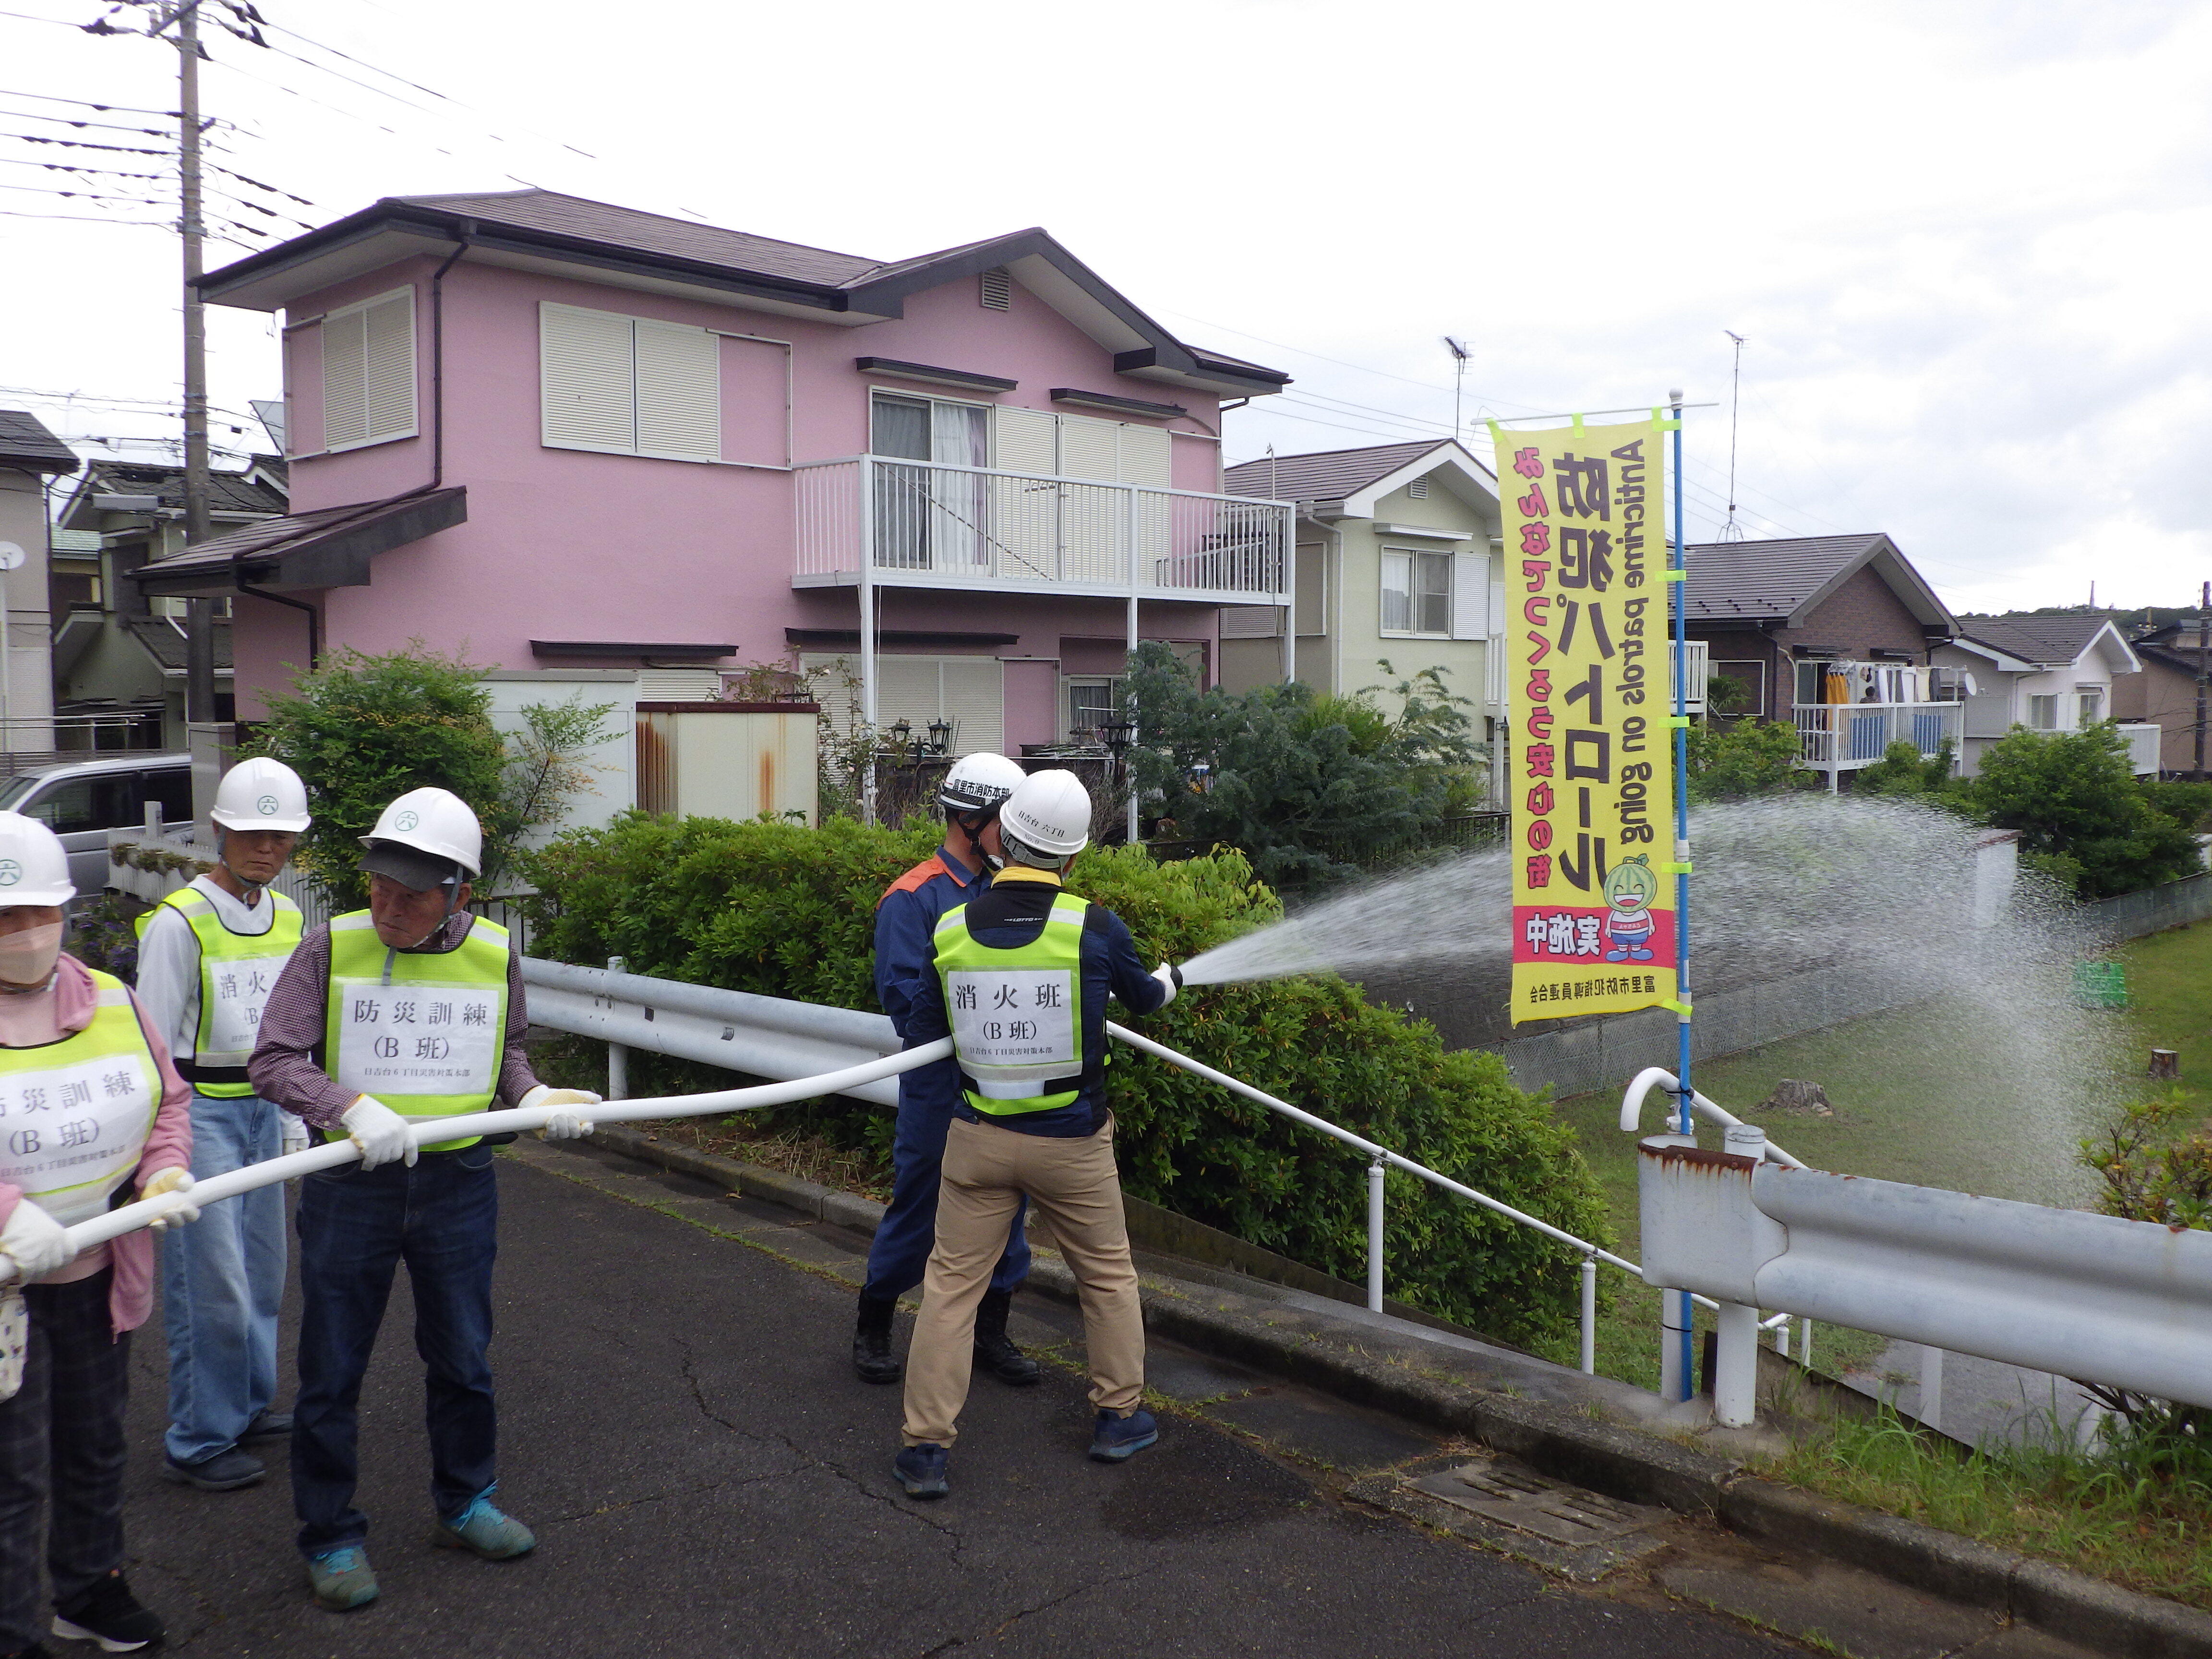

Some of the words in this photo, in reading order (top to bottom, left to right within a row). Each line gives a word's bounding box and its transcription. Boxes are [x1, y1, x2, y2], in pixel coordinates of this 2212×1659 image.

[952, 779, 1010, 799] 富里市消防本部
[220, 970, 284, 999] 消火
[354, 999, 487, 1026] 防災訓練
